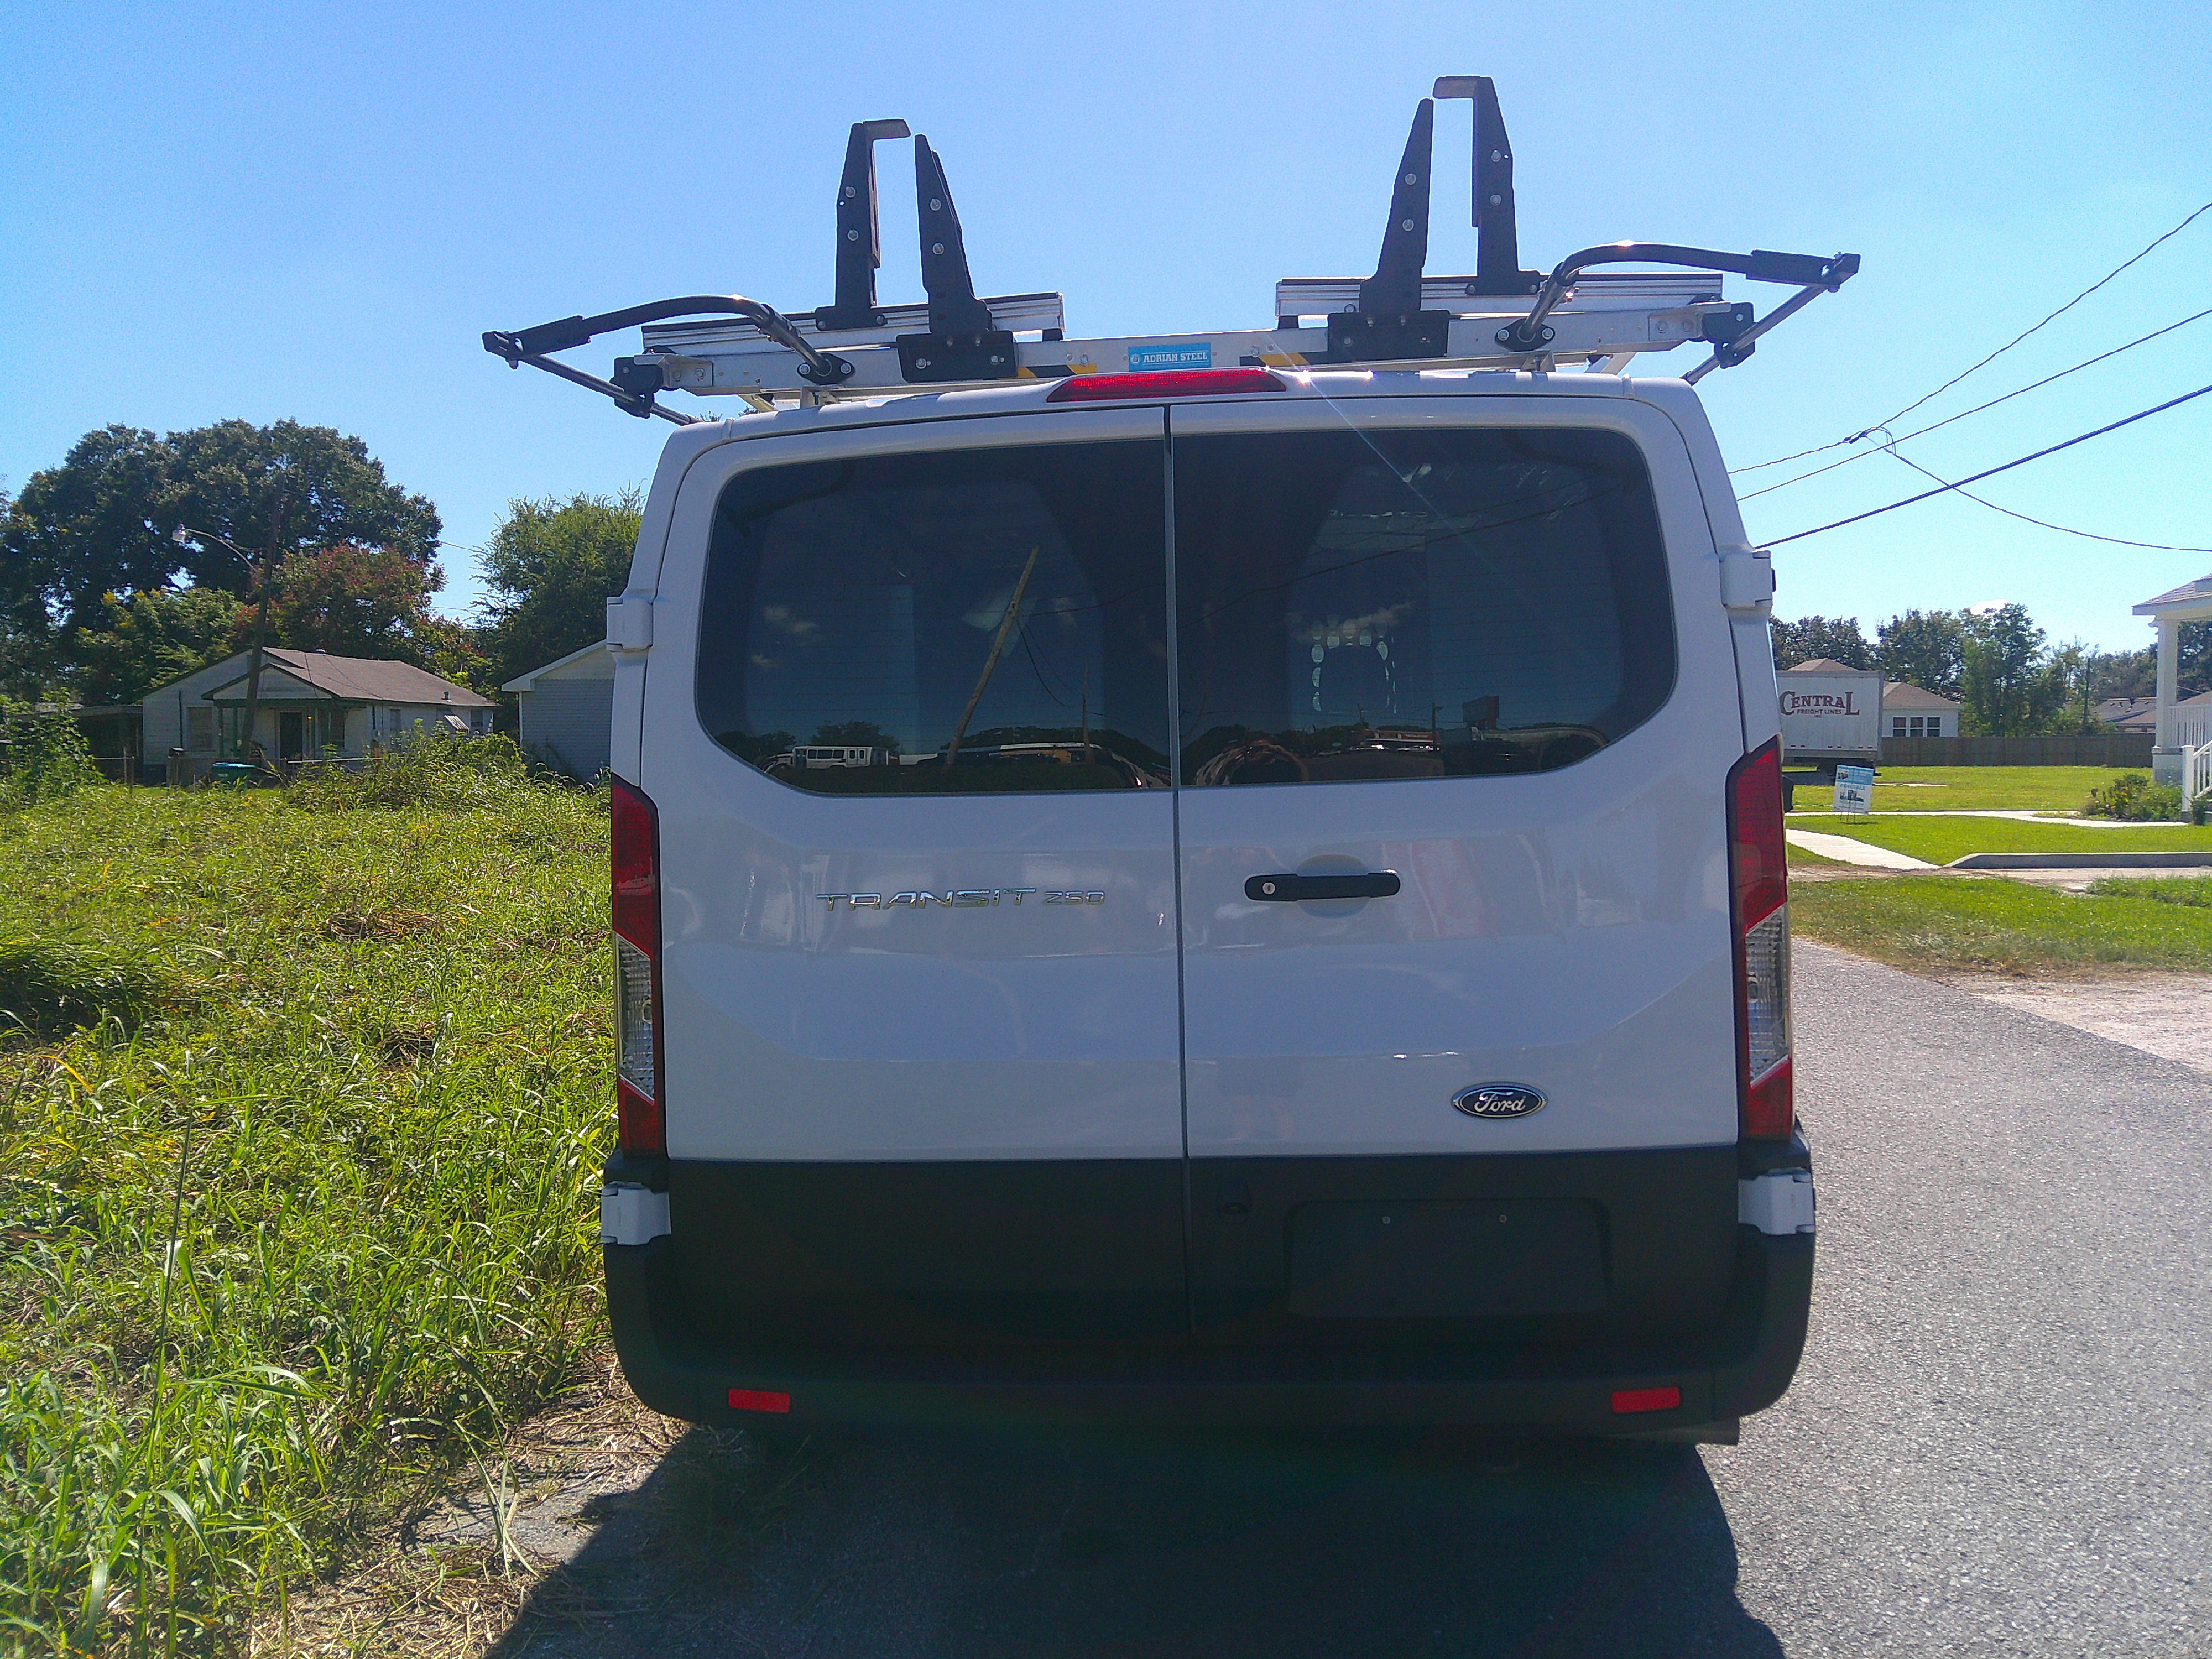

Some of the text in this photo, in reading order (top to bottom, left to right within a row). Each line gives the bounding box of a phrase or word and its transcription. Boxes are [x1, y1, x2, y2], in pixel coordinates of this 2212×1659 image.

[1143, 352, 1208, 363] ADRIAN STEEL
[1779, 691, 1860, 716] CENTRAL
[816, 888, 1105, 911] TRANSIT 250
[1474, 1091, 1526, 1113] Ford
